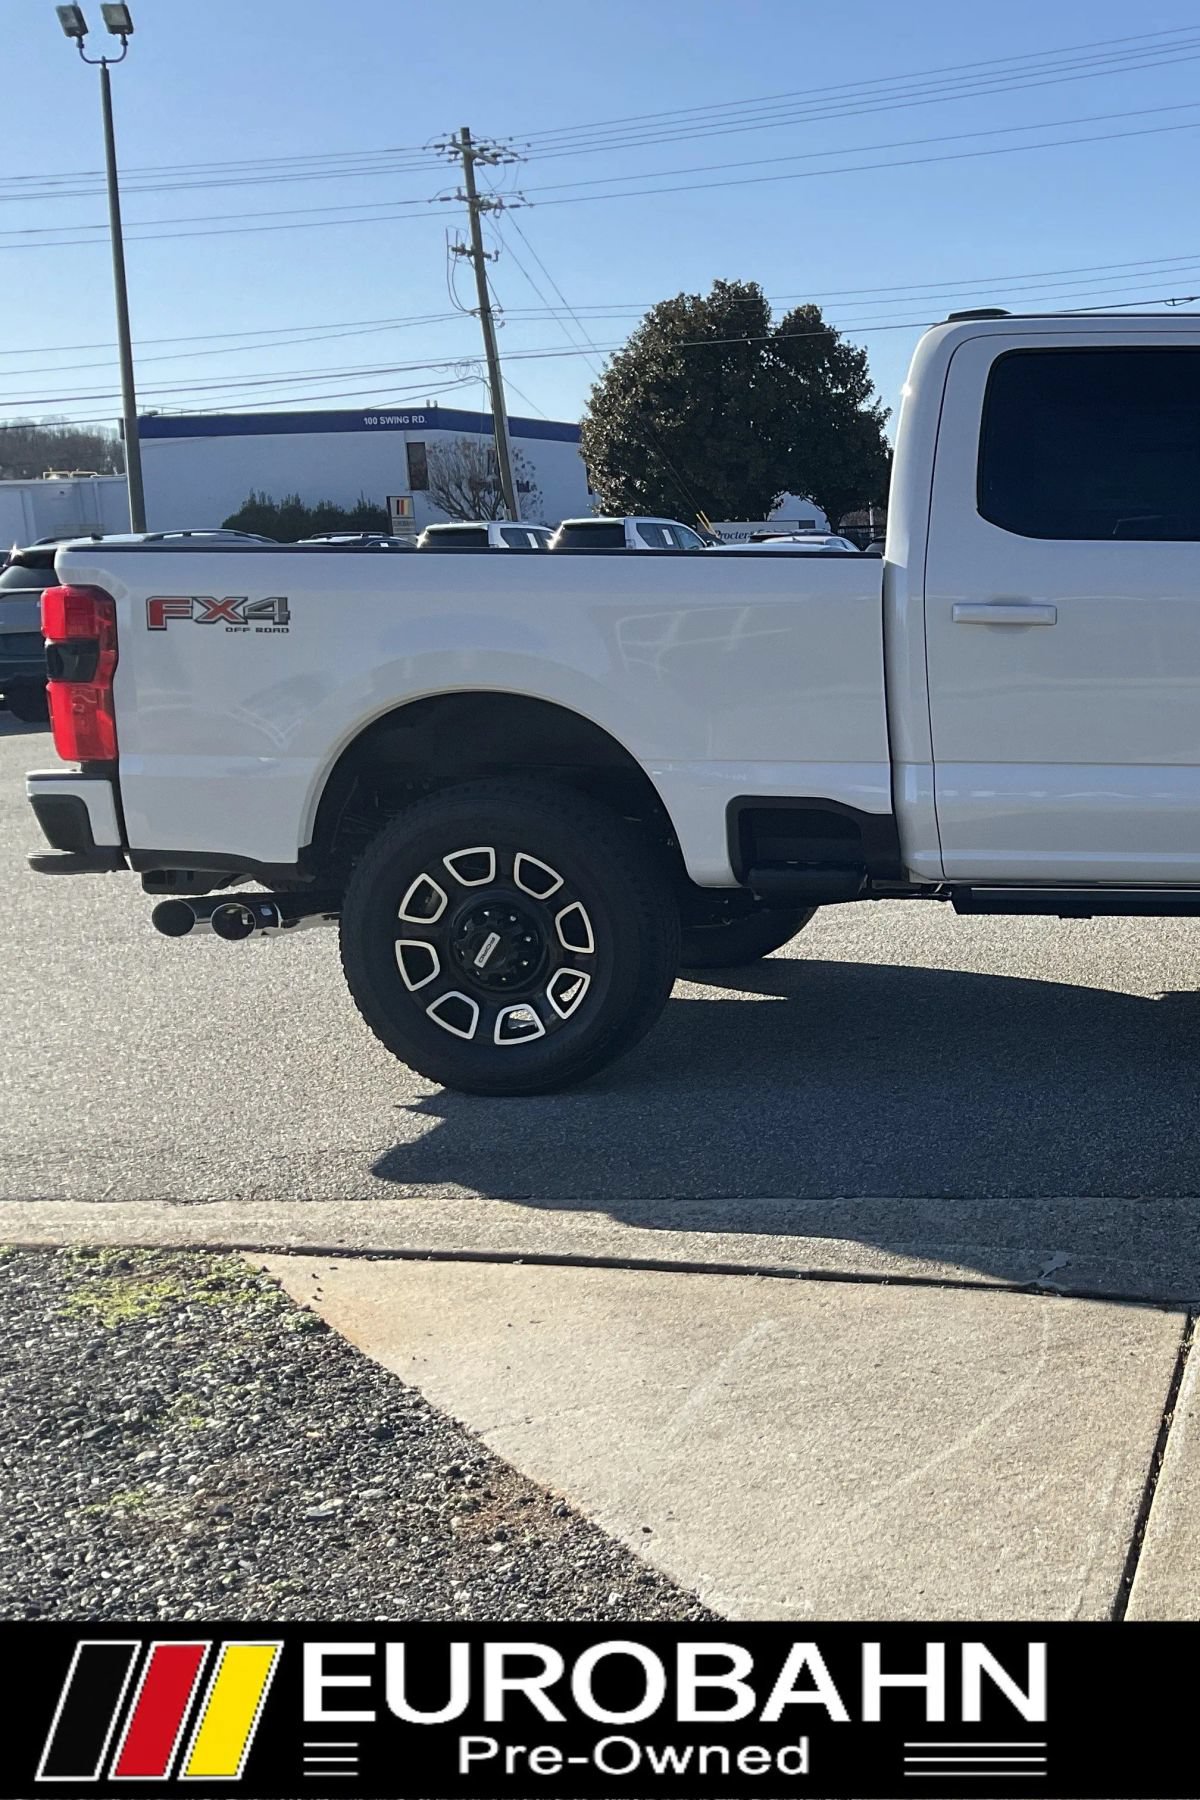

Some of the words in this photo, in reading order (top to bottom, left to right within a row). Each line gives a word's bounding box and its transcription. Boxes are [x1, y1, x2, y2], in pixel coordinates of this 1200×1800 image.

[364, 416, 378, 425] 100
[380, 415, 410, 425] SWING
[411, 415, 428, 424] RD.
[146, 596, 291, 631] FX4
[255, 626, 290, 634] ROAD
